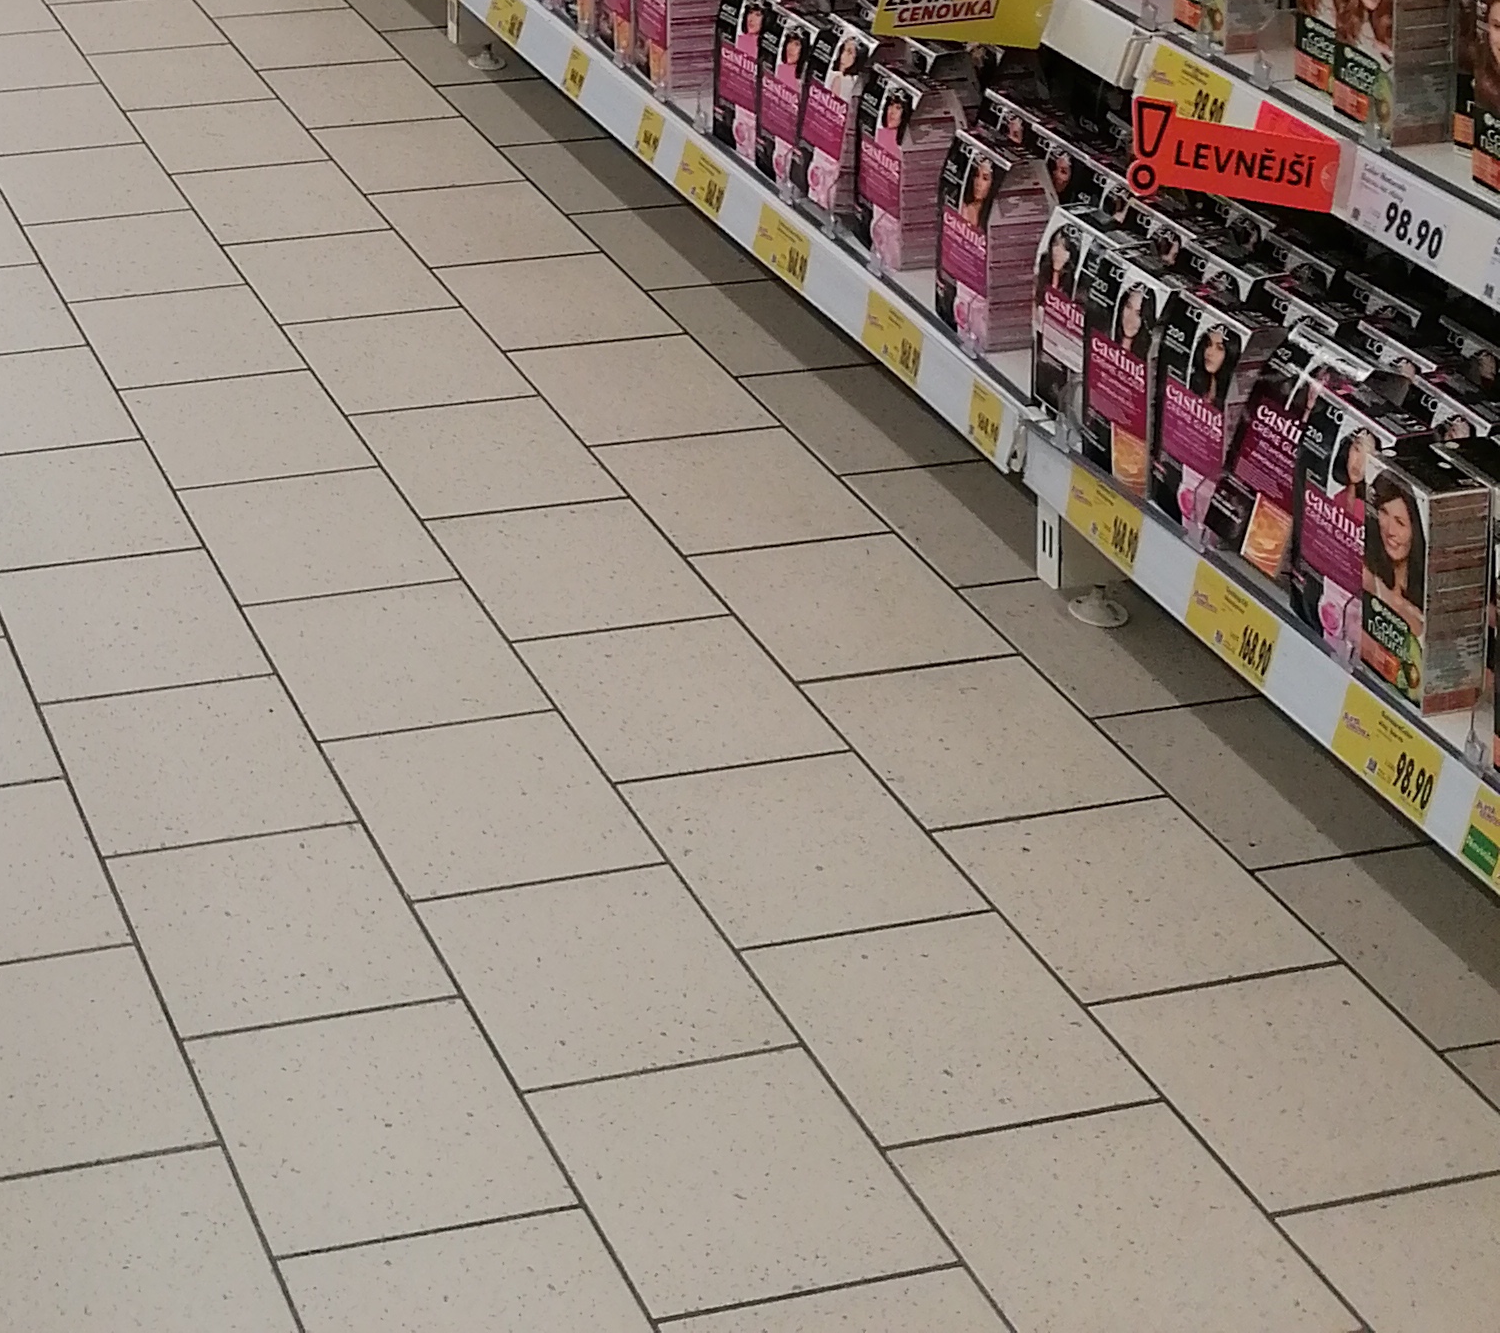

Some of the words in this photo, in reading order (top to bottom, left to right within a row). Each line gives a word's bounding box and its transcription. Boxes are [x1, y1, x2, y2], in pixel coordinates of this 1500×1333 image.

[898, 0, 992, 23] CENOVKA
[1175, 139, 1314, 188] LEVNĚJŠÍ
[1384, 202, 1443, 260] 98.90
[1166, 384, 1223, 430] casting
[1368, 618, 1409, 659] natural
[1393, 751, 1434, 810] 98.90
